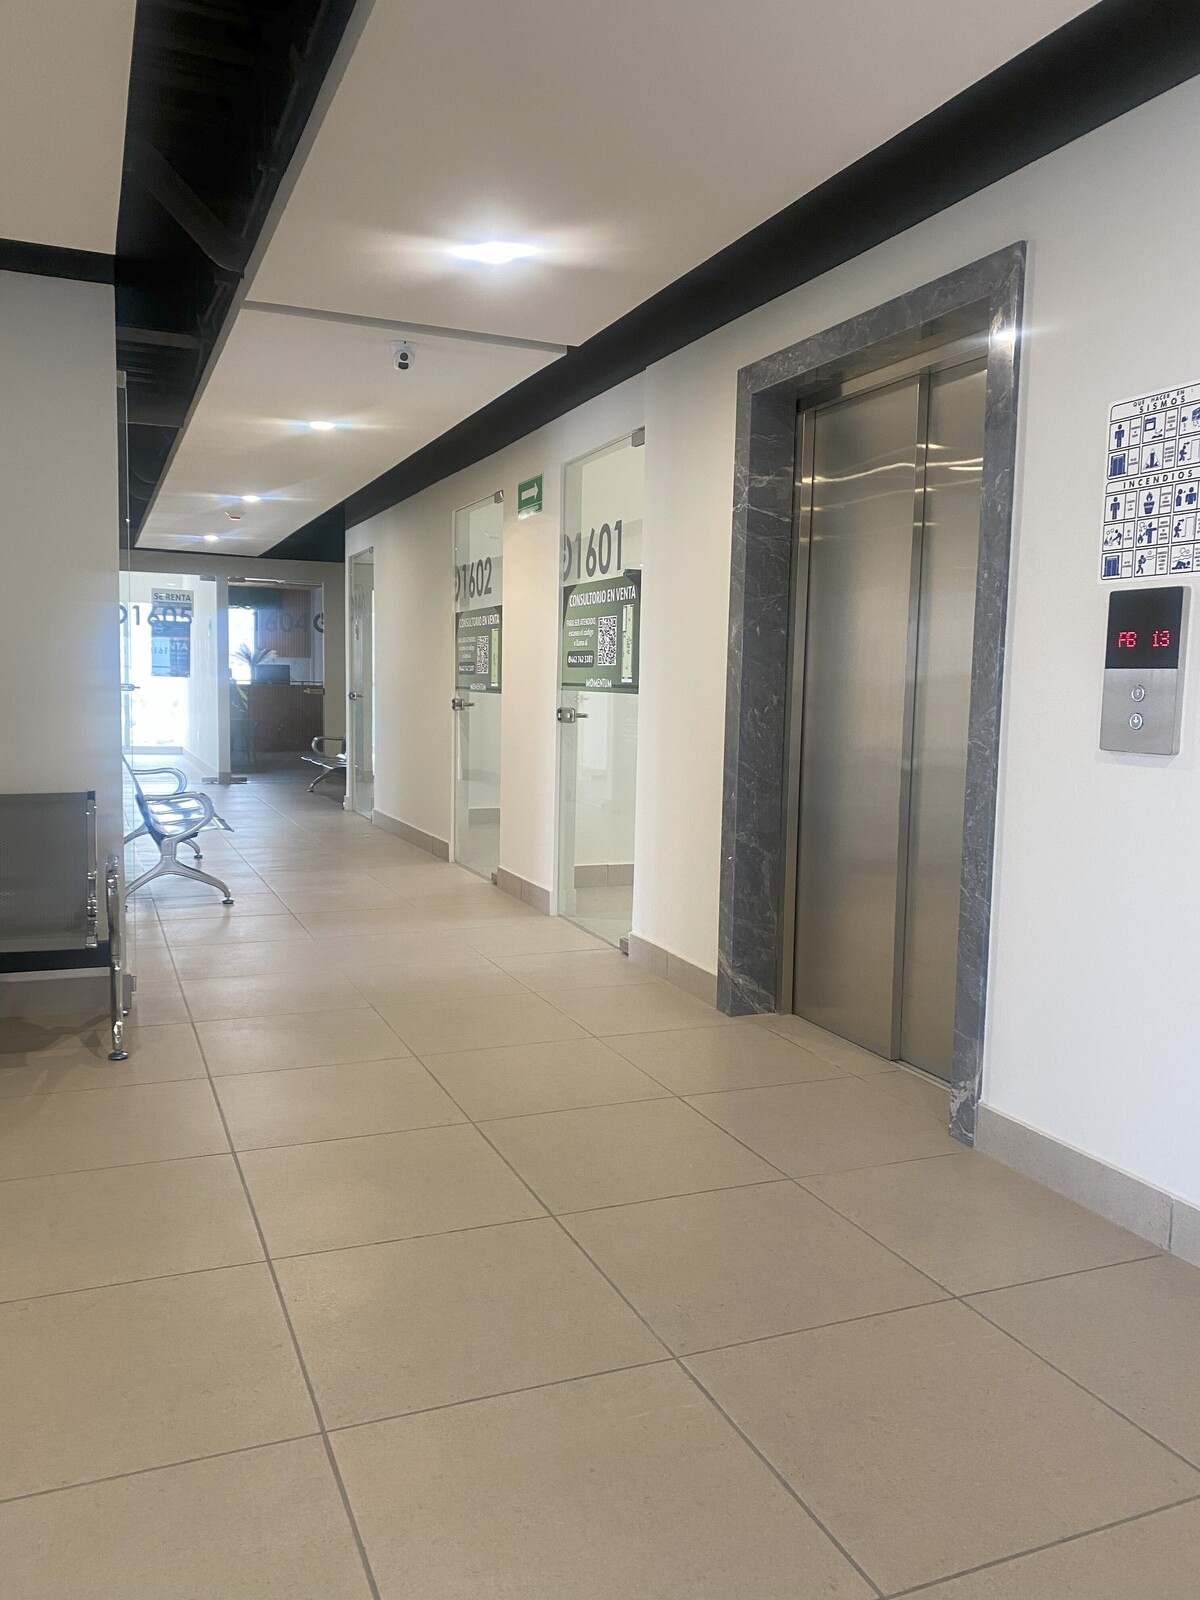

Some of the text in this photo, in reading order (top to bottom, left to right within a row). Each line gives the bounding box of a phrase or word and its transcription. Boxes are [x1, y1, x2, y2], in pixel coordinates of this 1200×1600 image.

[1139, 395, 1186, 414] SISMOS
[1150, 393, 1170, 403] HACER
[1123, 469, 1194, 490] INCENDIOS
[165, 593, 192, 602] RENTA
[569, 585, 636, 607] CONSULTORIO EN VENTA
[1152, 630, 1170, 647] 13
[585, 678, 613, 689] MOMENTUM
